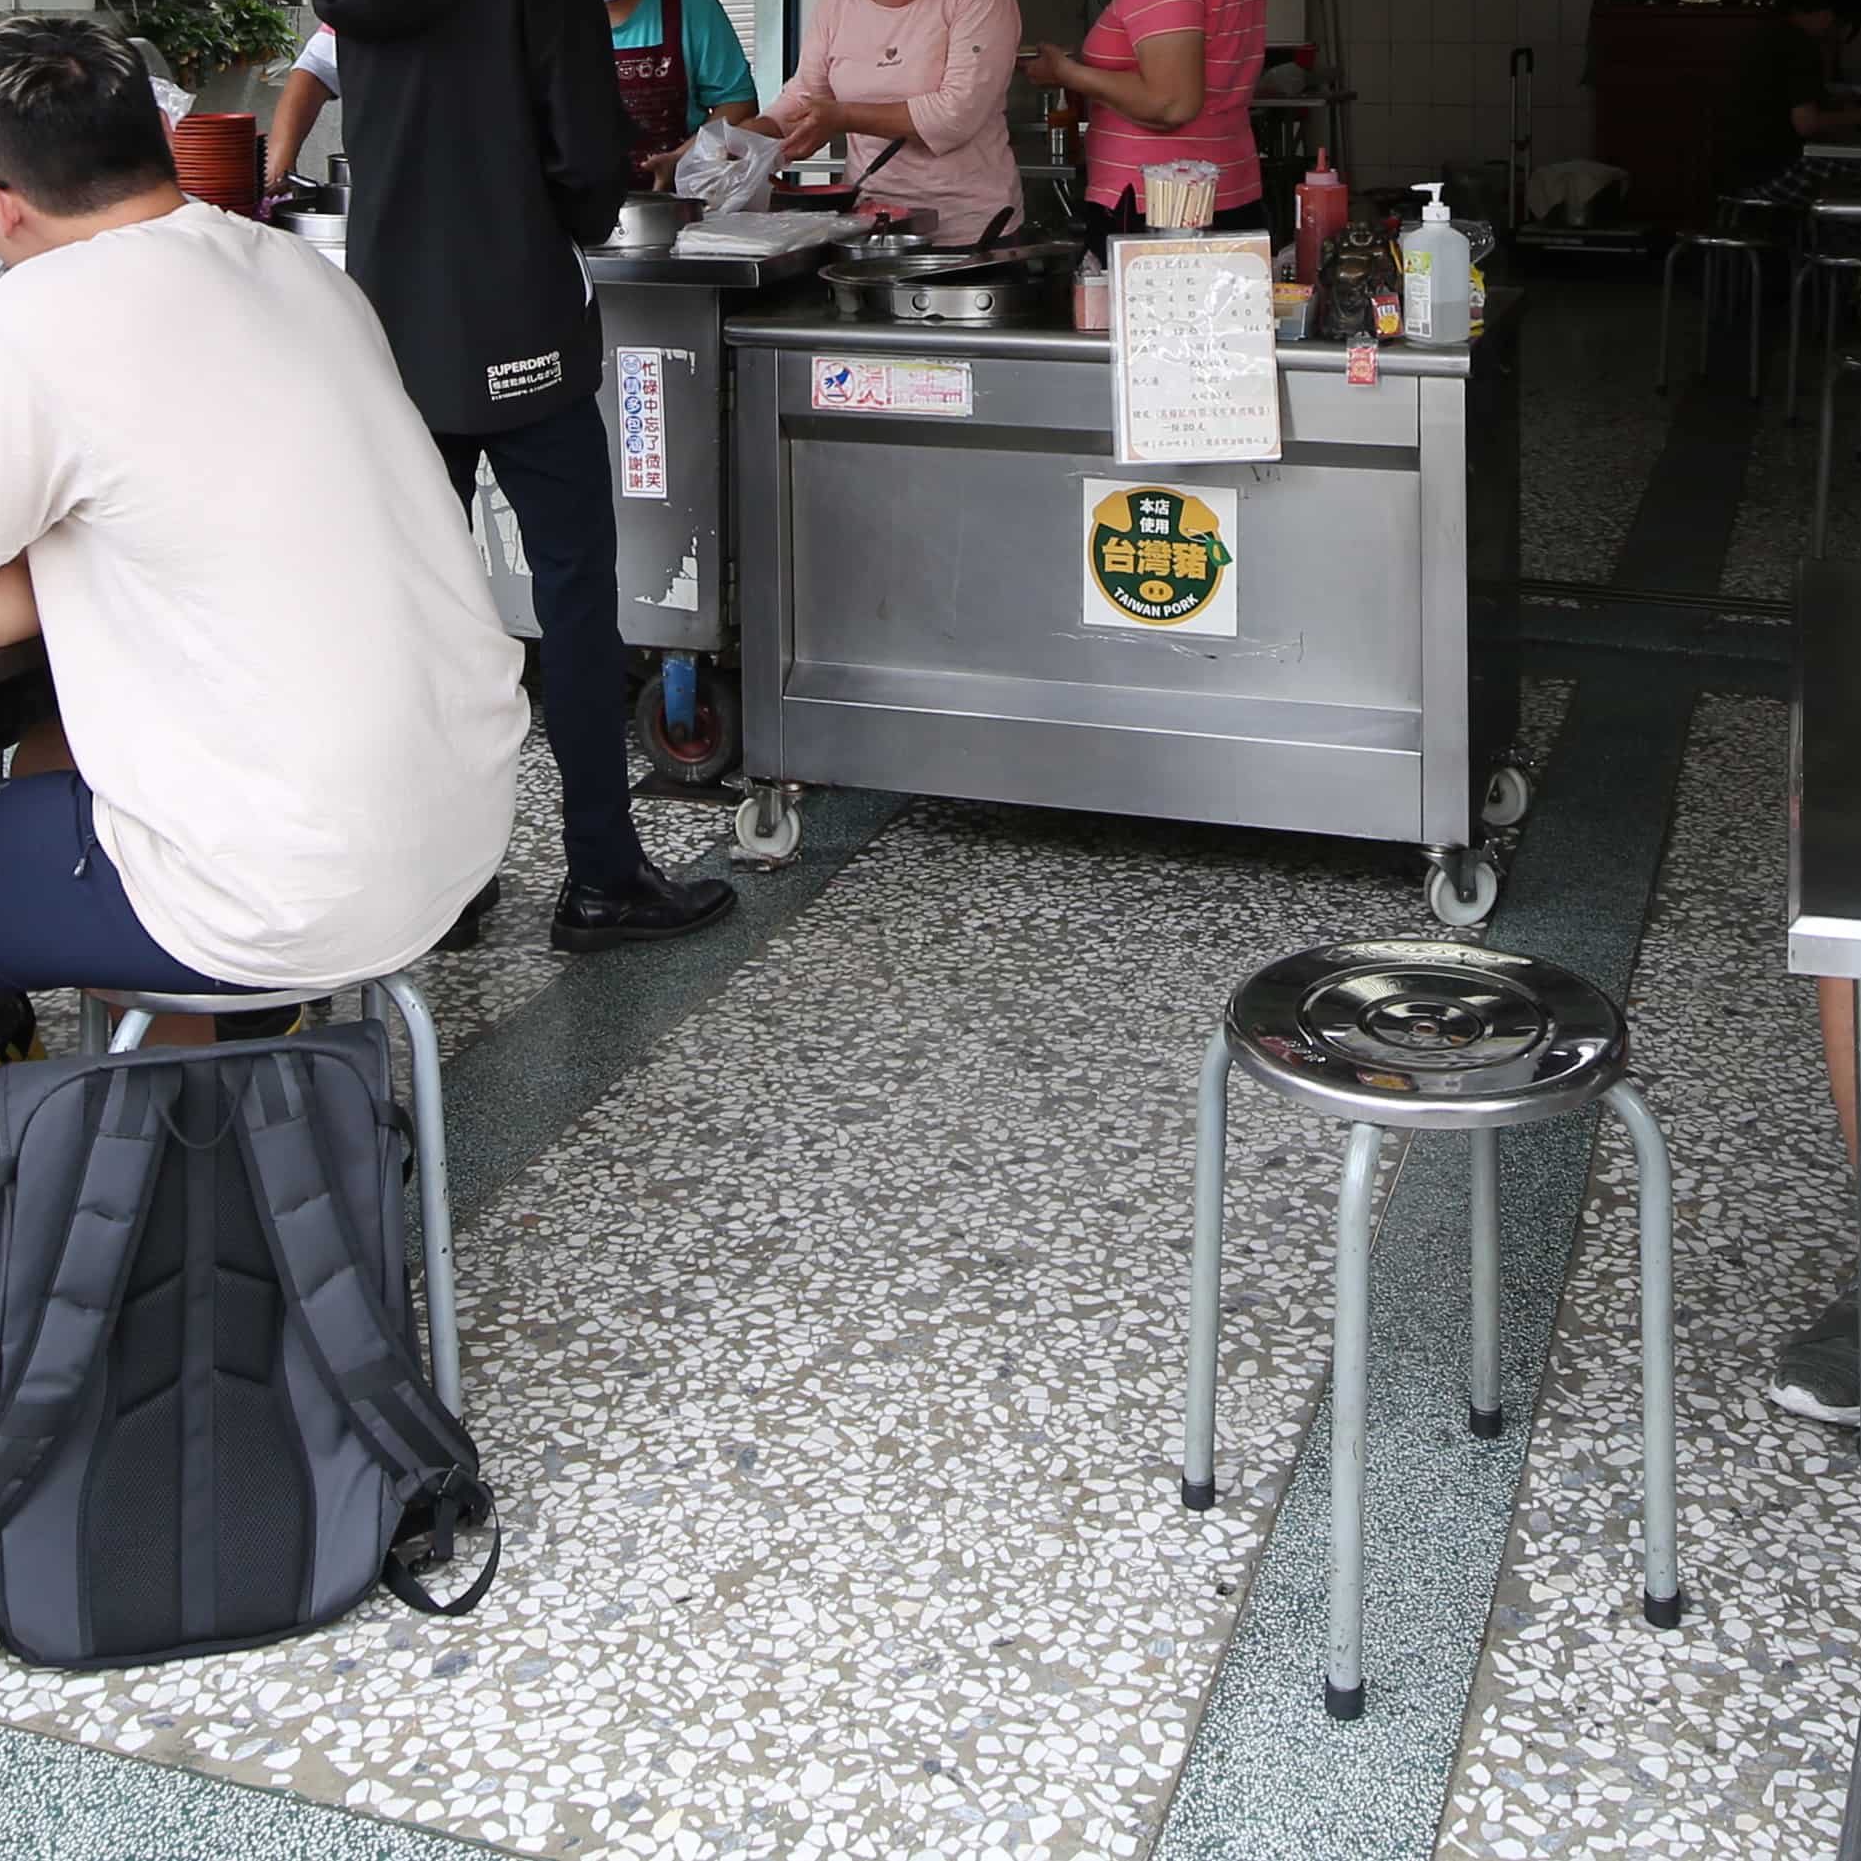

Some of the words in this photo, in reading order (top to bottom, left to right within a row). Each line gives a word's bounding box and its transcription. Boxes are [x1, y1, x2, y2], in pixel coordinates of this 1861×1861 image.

[1139, 497, 1171, 516] 本店
[1139, 517, 1170, 535] 使用
[1101, 536, 1209, 581] 台灣豬
[1113, 586, 1161, 618] TAIWAN
[1163, 592, 1200, 618] PORK
